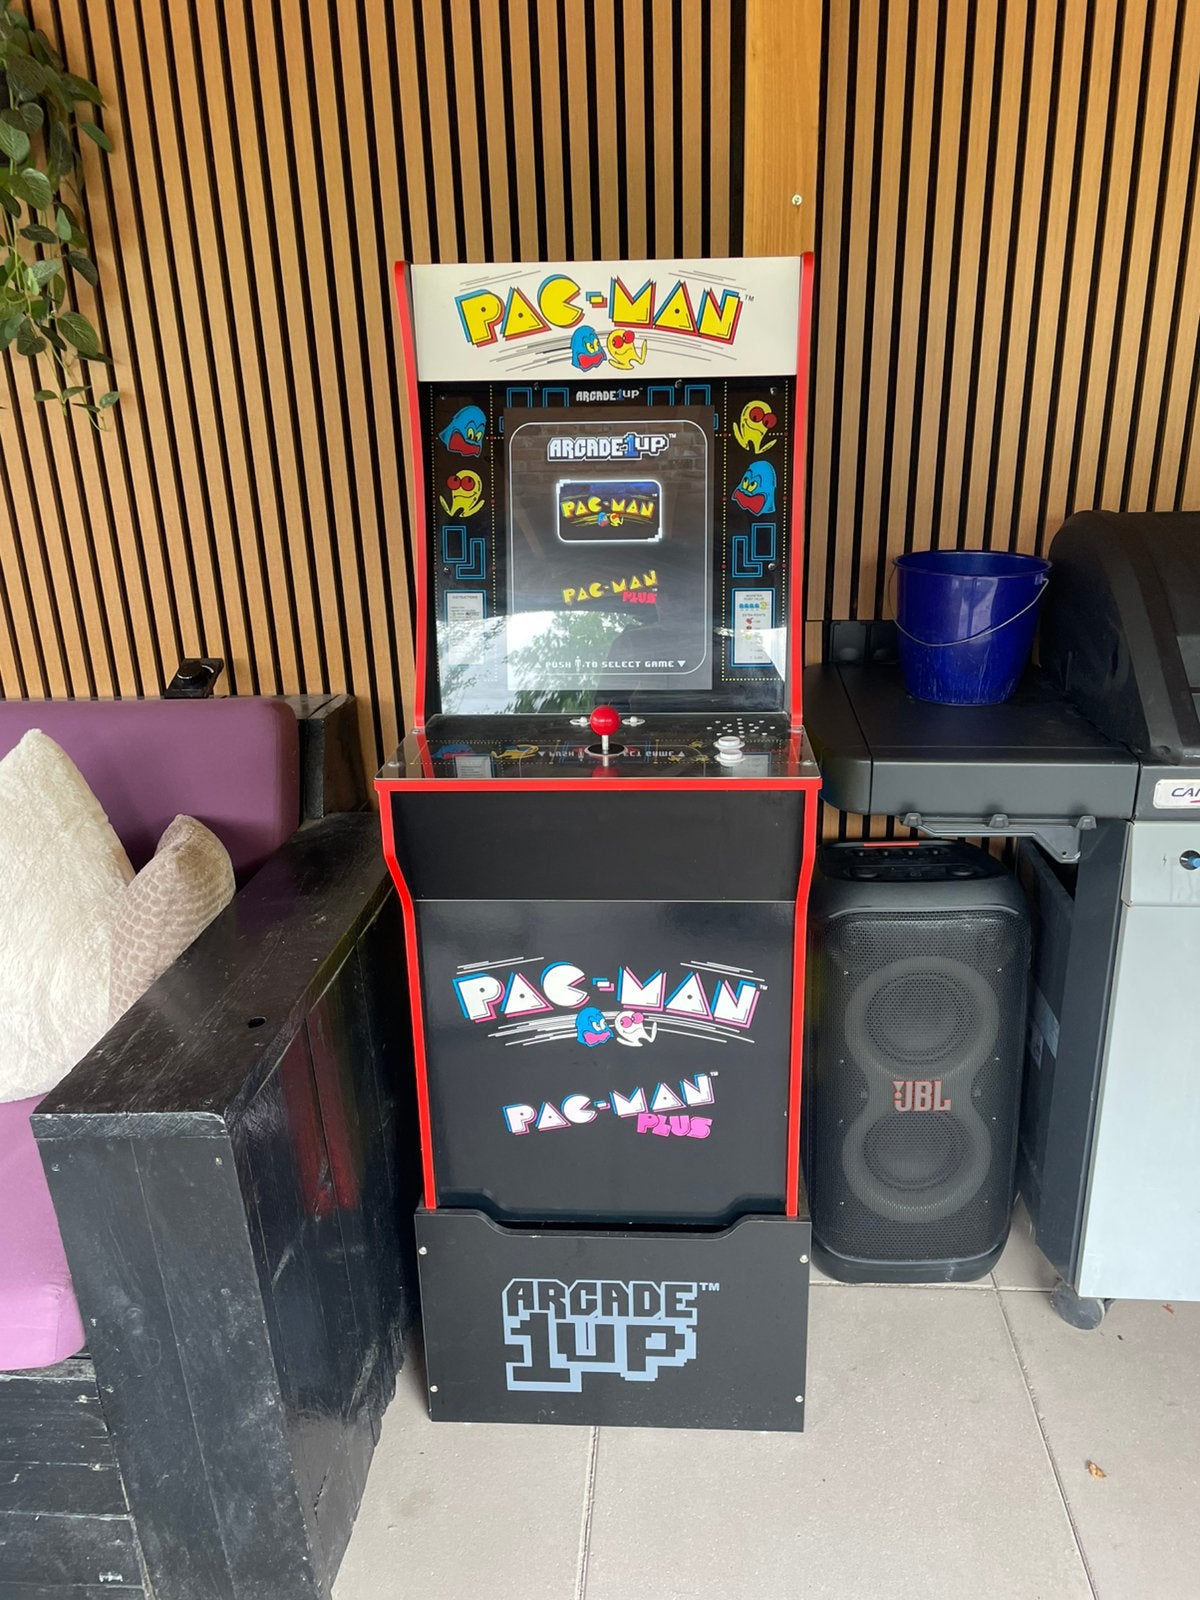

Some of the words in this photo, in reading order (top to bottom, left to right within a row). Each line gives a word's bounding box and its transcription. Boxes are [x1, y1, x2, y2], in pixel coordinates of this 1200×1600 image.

[455, 274, 743, 347] PAC-MAN
[561, 496, 655, 519] PAC-MAN
[562, 569, 658, 606] PAC-MAN
[622, 591, 657, 604] PLUS
[545, 660, 571, 668] PUSH
[601, 660, 641, 668] SELECT
[644, 660, 675, 668] GAME
[452, 961, 760, 1028] PAC-MAN
[502, 1073, 715, 1135] PAC-MAN
[892, 1080, 952, 1112] JBL
[637, 1113, 712, 1139] PLUS
[502, 1278, 697, 1320] ARCADE
[504, 1312, 697, 1392] 1UP
